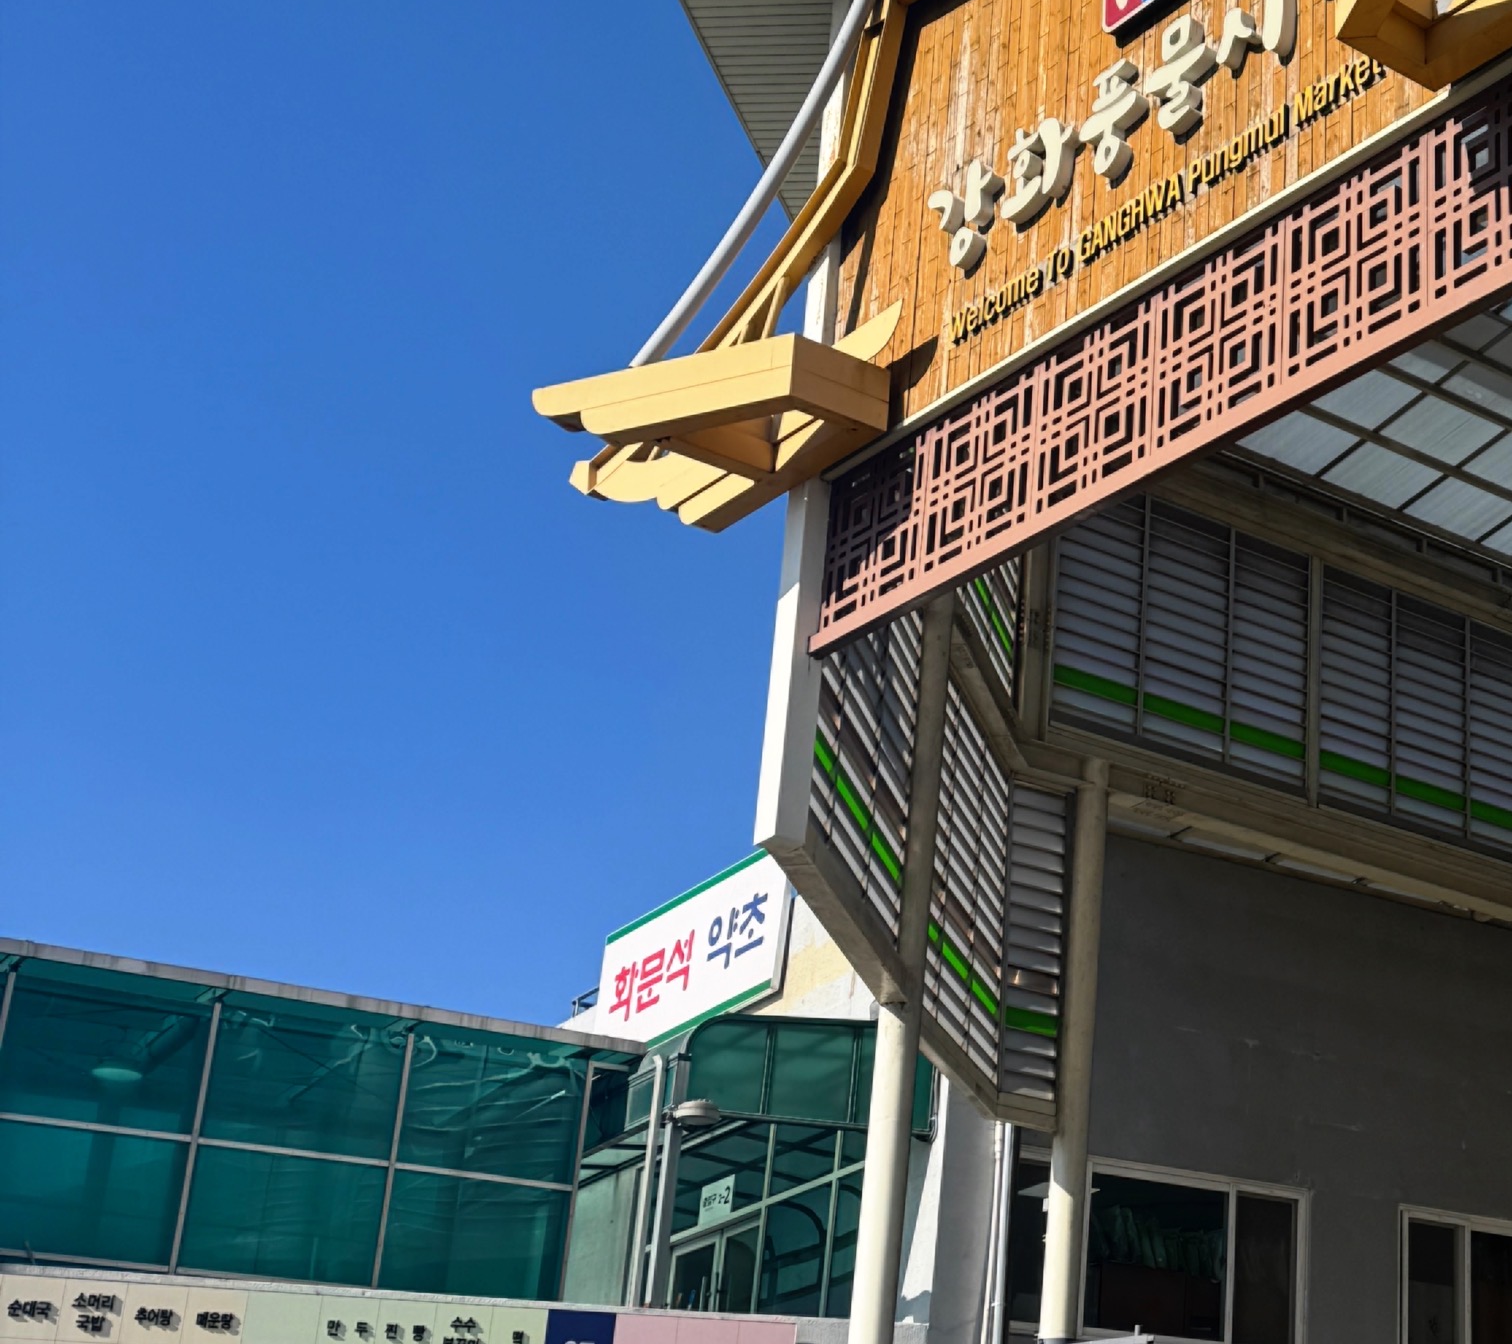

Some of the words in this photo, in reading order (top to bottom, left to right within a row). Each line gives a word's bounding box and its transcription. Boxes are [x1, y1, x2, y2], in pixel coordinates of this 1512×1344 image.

[945, 269, 1040, 343] Welcome
[1077, 174, 1183, 265] GANGHWA
[1187, 105, 1290, 196] Pungmul
[608, 929, 695, 1022] 화문석
[706, 892, 769, 970] 약초
[8, 1300, 51, 1319] 순대국
[72, 1293, 115, 1311] 소머리
[77, 1315, 105, 1332] 국밥
[135, 1308, 173, 1326] 추어탕
[197, 1312, 233, 1330] 매운탕
[451, 1317, 476, 1333] 수수
